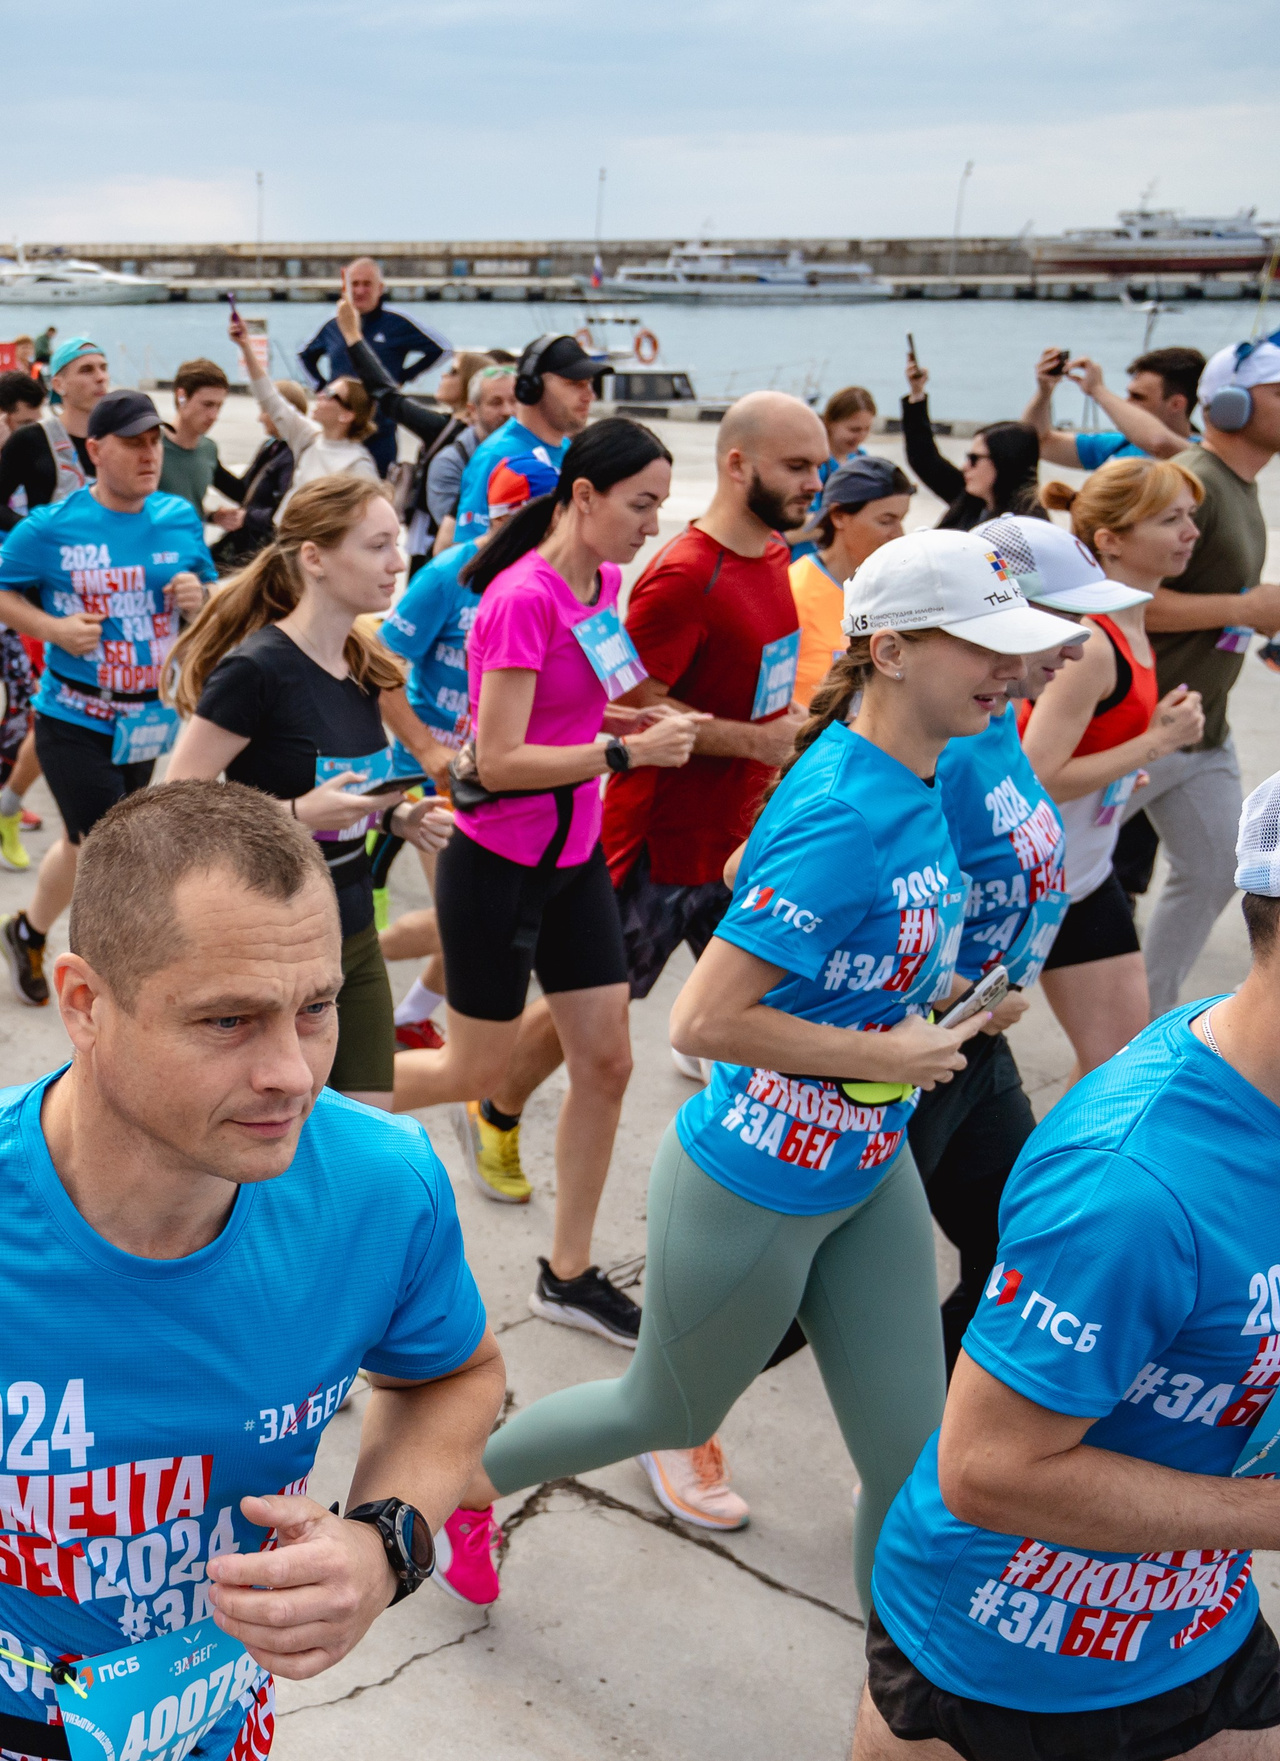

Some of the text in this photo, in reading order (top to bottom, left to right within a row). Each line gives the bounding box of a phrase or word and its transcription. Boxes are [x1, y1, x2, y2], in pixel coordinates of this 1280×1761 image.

[60, 544, 112, 571] 2024
[985, 775, 1033, 837] 2024
[771, 897, 823, 934] ПСБ
[720, 1093, 842, 1171] #ЗАБЕГ
[1020, 1290, 1103, 1353] ПСБ
[1000, 1539, 1229, 1613] #ЛЮБОВЬ
[969, 1578, 1154, 1662] #ЗАБЕГ
[97, 1655, 141, 1683] ПСБ
[120, 1651, 259, 1761] 40078
